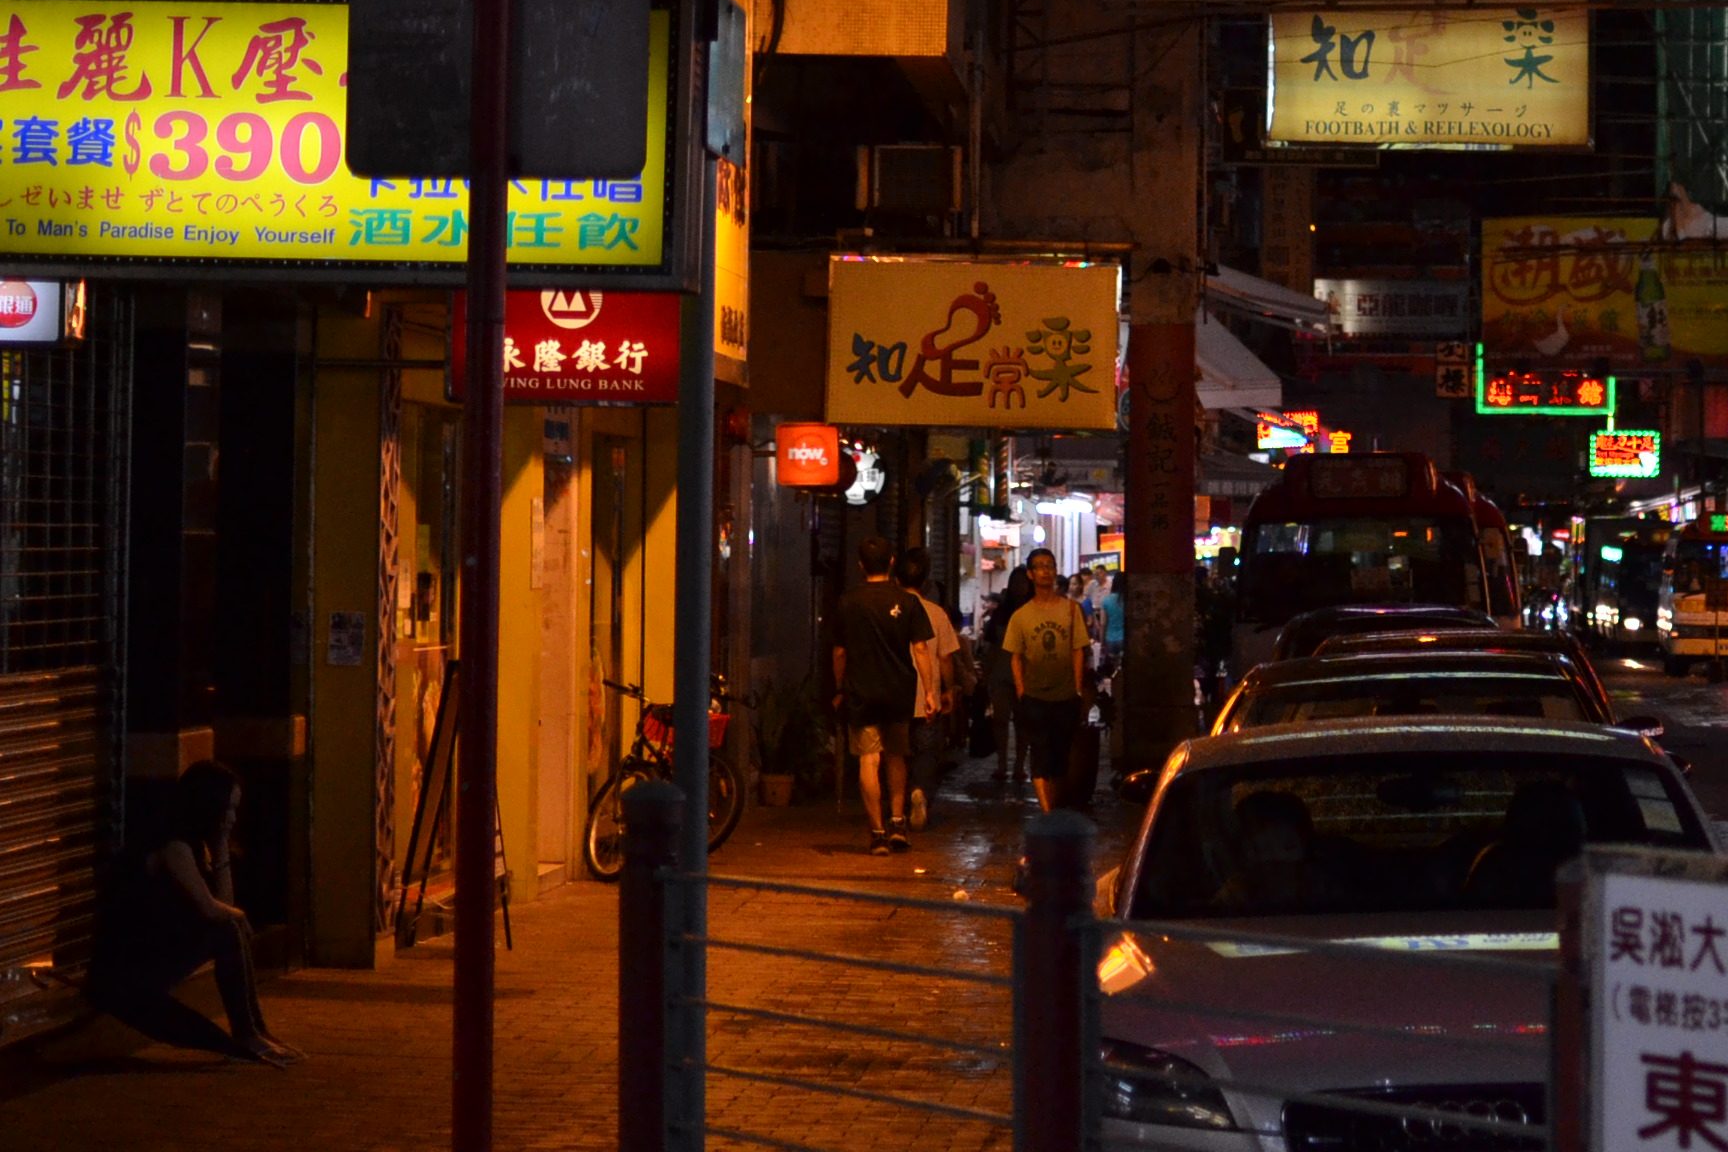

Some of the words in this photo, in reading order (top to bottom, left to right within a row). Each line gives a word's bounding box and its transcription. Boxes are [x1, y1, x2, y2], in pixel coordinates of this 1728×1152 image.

[0, 10, 348, 104] 麗K壓
[1304, 120, 1400, 137] FOOTBATH
[1404, 121, 1418, 136] &
[1423, 121, 1554, 139] REFLEXOLOGY
[0, 117, 118, 169] 套餐
[122, 107, 342, 185] $390
[7, 218, 27, 237] To
[37, 219, 89, 239] Man's
[100, 221, 175, 240] Paradise
[183, 224, 240, 246] Enjoy
[255, 226, 337, 246] Yourself
[501, 377, 540, 389] ING
[546, 378, 592, 390] LUNG
[598, 379, 645, 391] BANK
